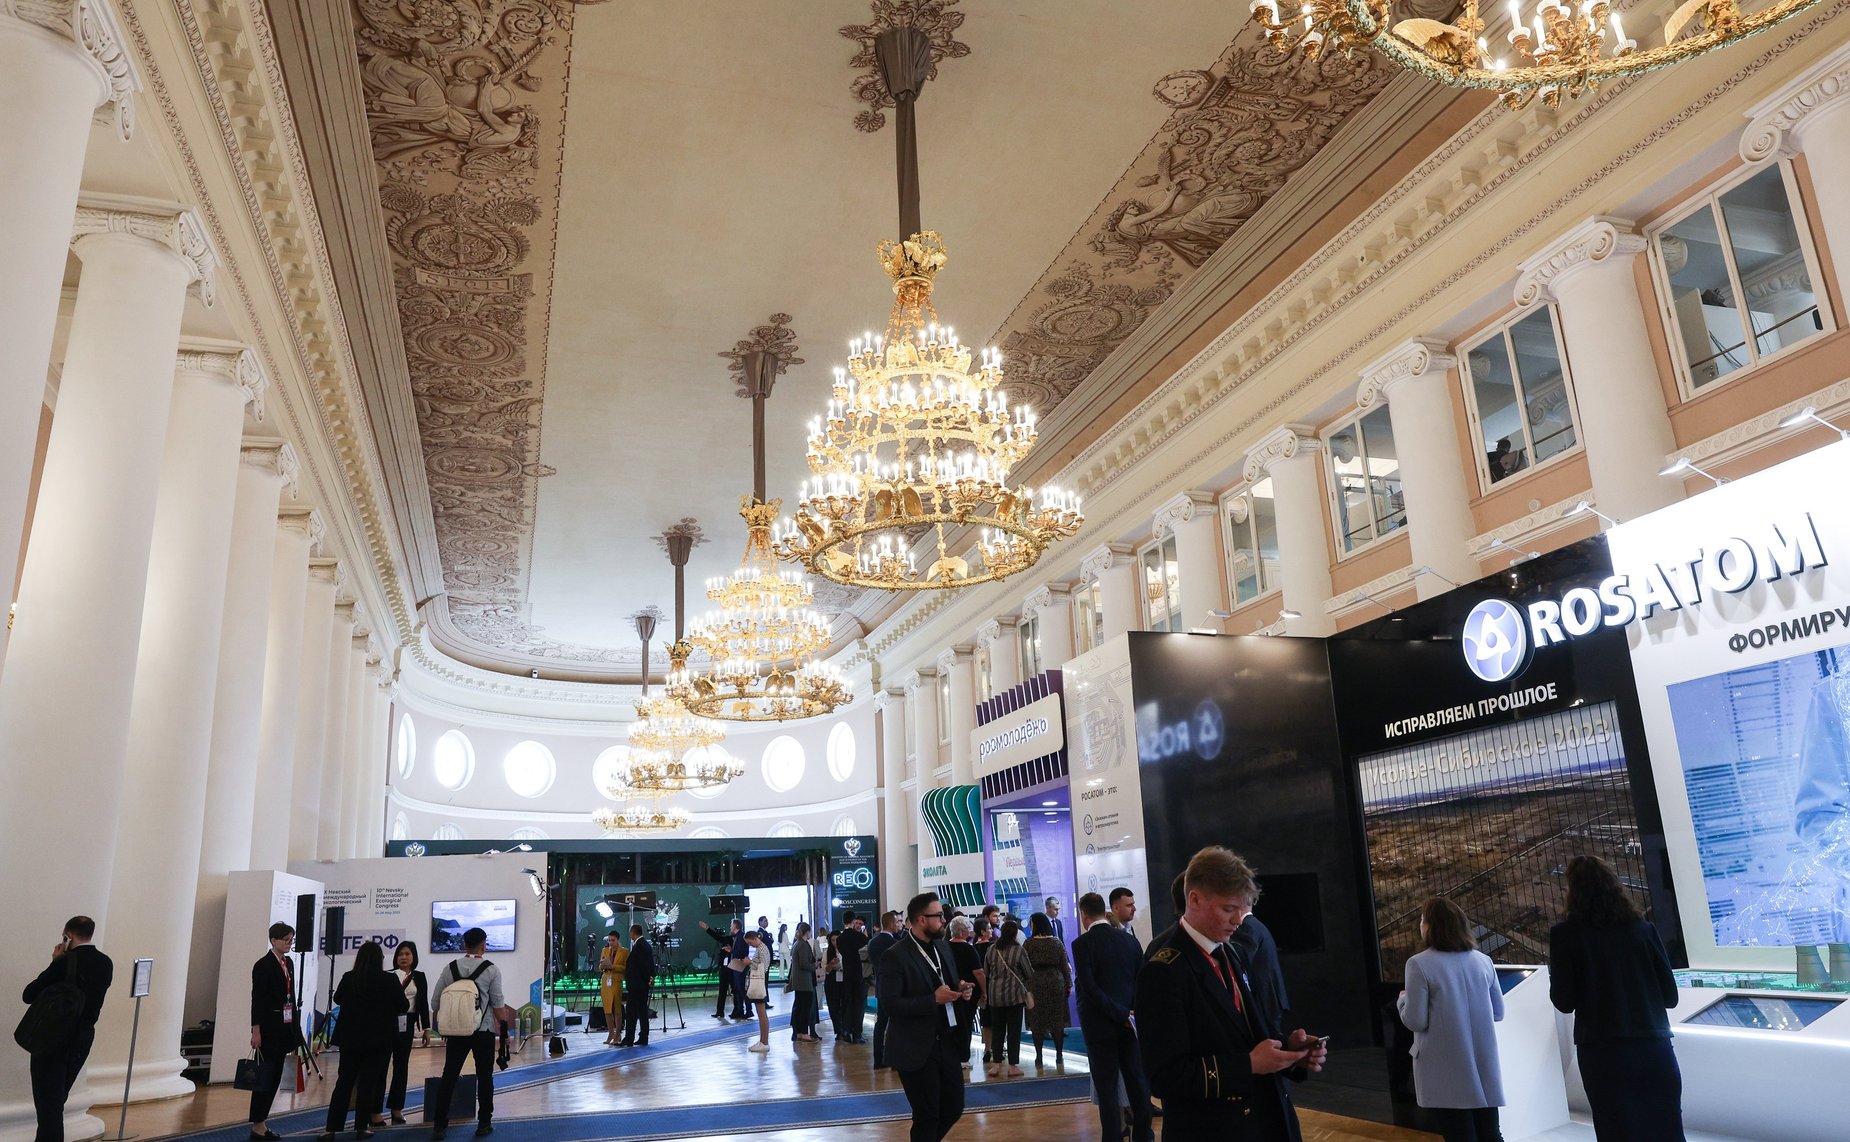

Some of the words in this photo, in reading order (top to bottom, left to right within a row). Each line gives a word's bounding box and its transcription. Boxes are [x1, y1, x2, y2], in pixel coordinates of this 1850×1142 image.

[1528, 512, 1829, 648] ROSATOM
[1728, 605, 1850, 653] ФОРМИРУ
[1385, 703, 1476, 739] ИСПРАВЛЯЕМ
[1478, 682, 1558, 717] ПРОШЛОЕ
[979, 718, 1047, 764] росмолодёжь
[1551, 719, 1612, 752] 2023
[1081, 788, 1104, 801] РОСАТОМ
[834, 868, 873, 889] REO
